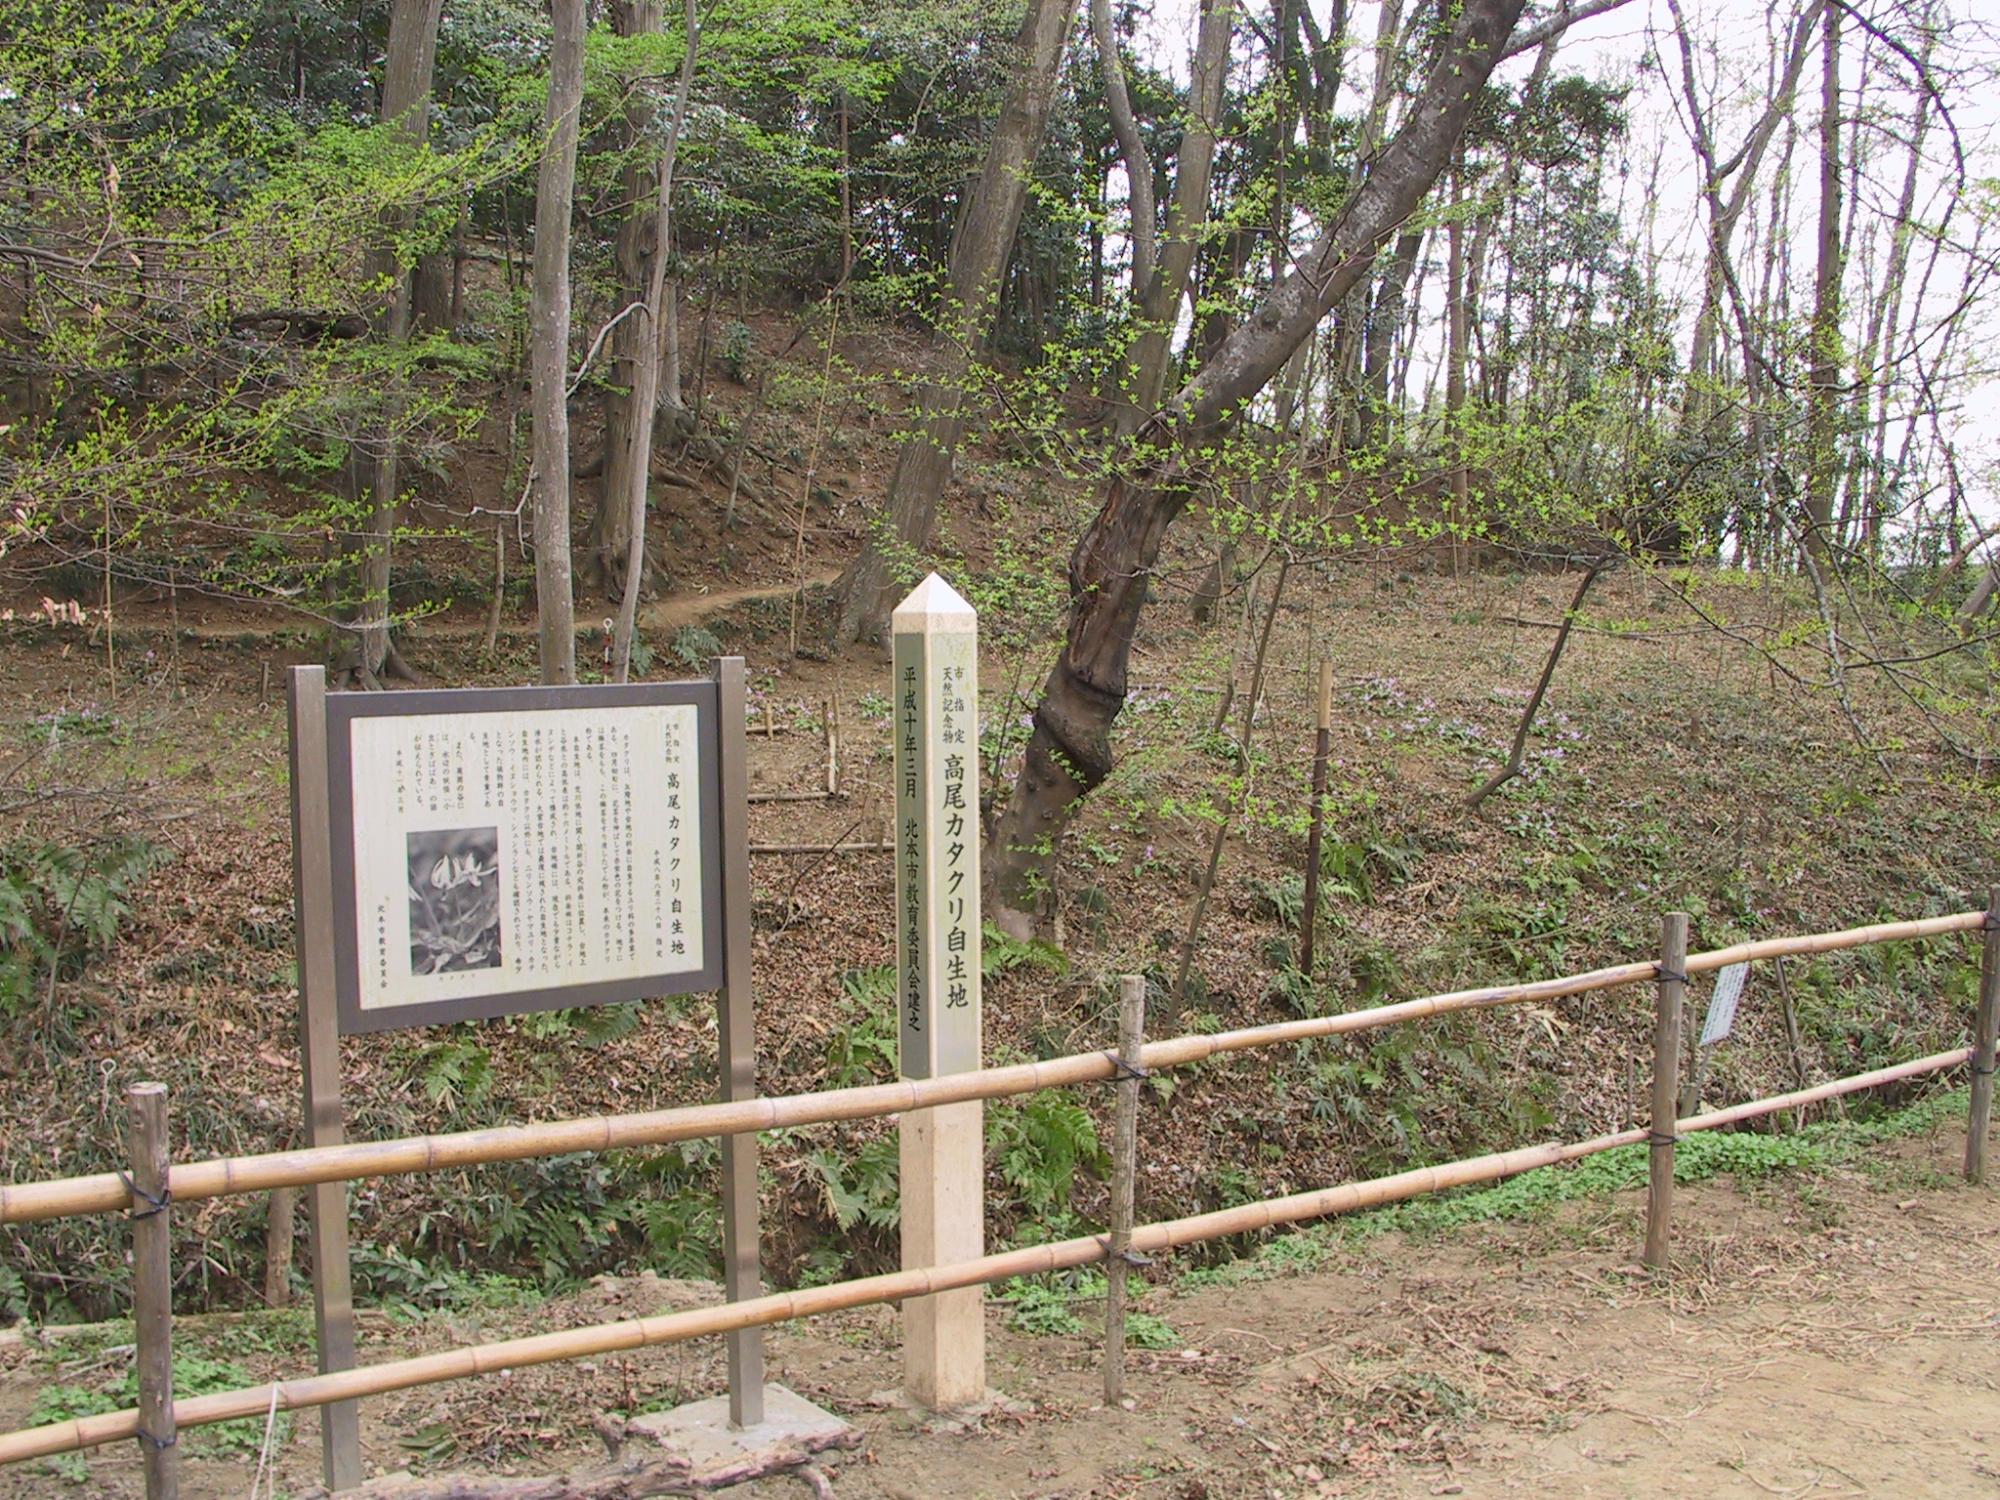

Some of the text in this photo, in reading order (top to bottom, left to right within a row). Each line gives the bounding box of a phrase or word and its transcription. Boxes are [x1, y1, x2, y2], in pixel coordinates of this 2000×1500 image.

[942, 666, 954, 744] 天然記念物
[954, 666, 966, 744] 市指定
[666, 771, 685, 955] 高尾カタクリ自生地
[903, 666, 921, 1032] 平成十年三月 北本市教育委員会建之
[943, 753, 969, 1009] 高尾カタクリ自生地
